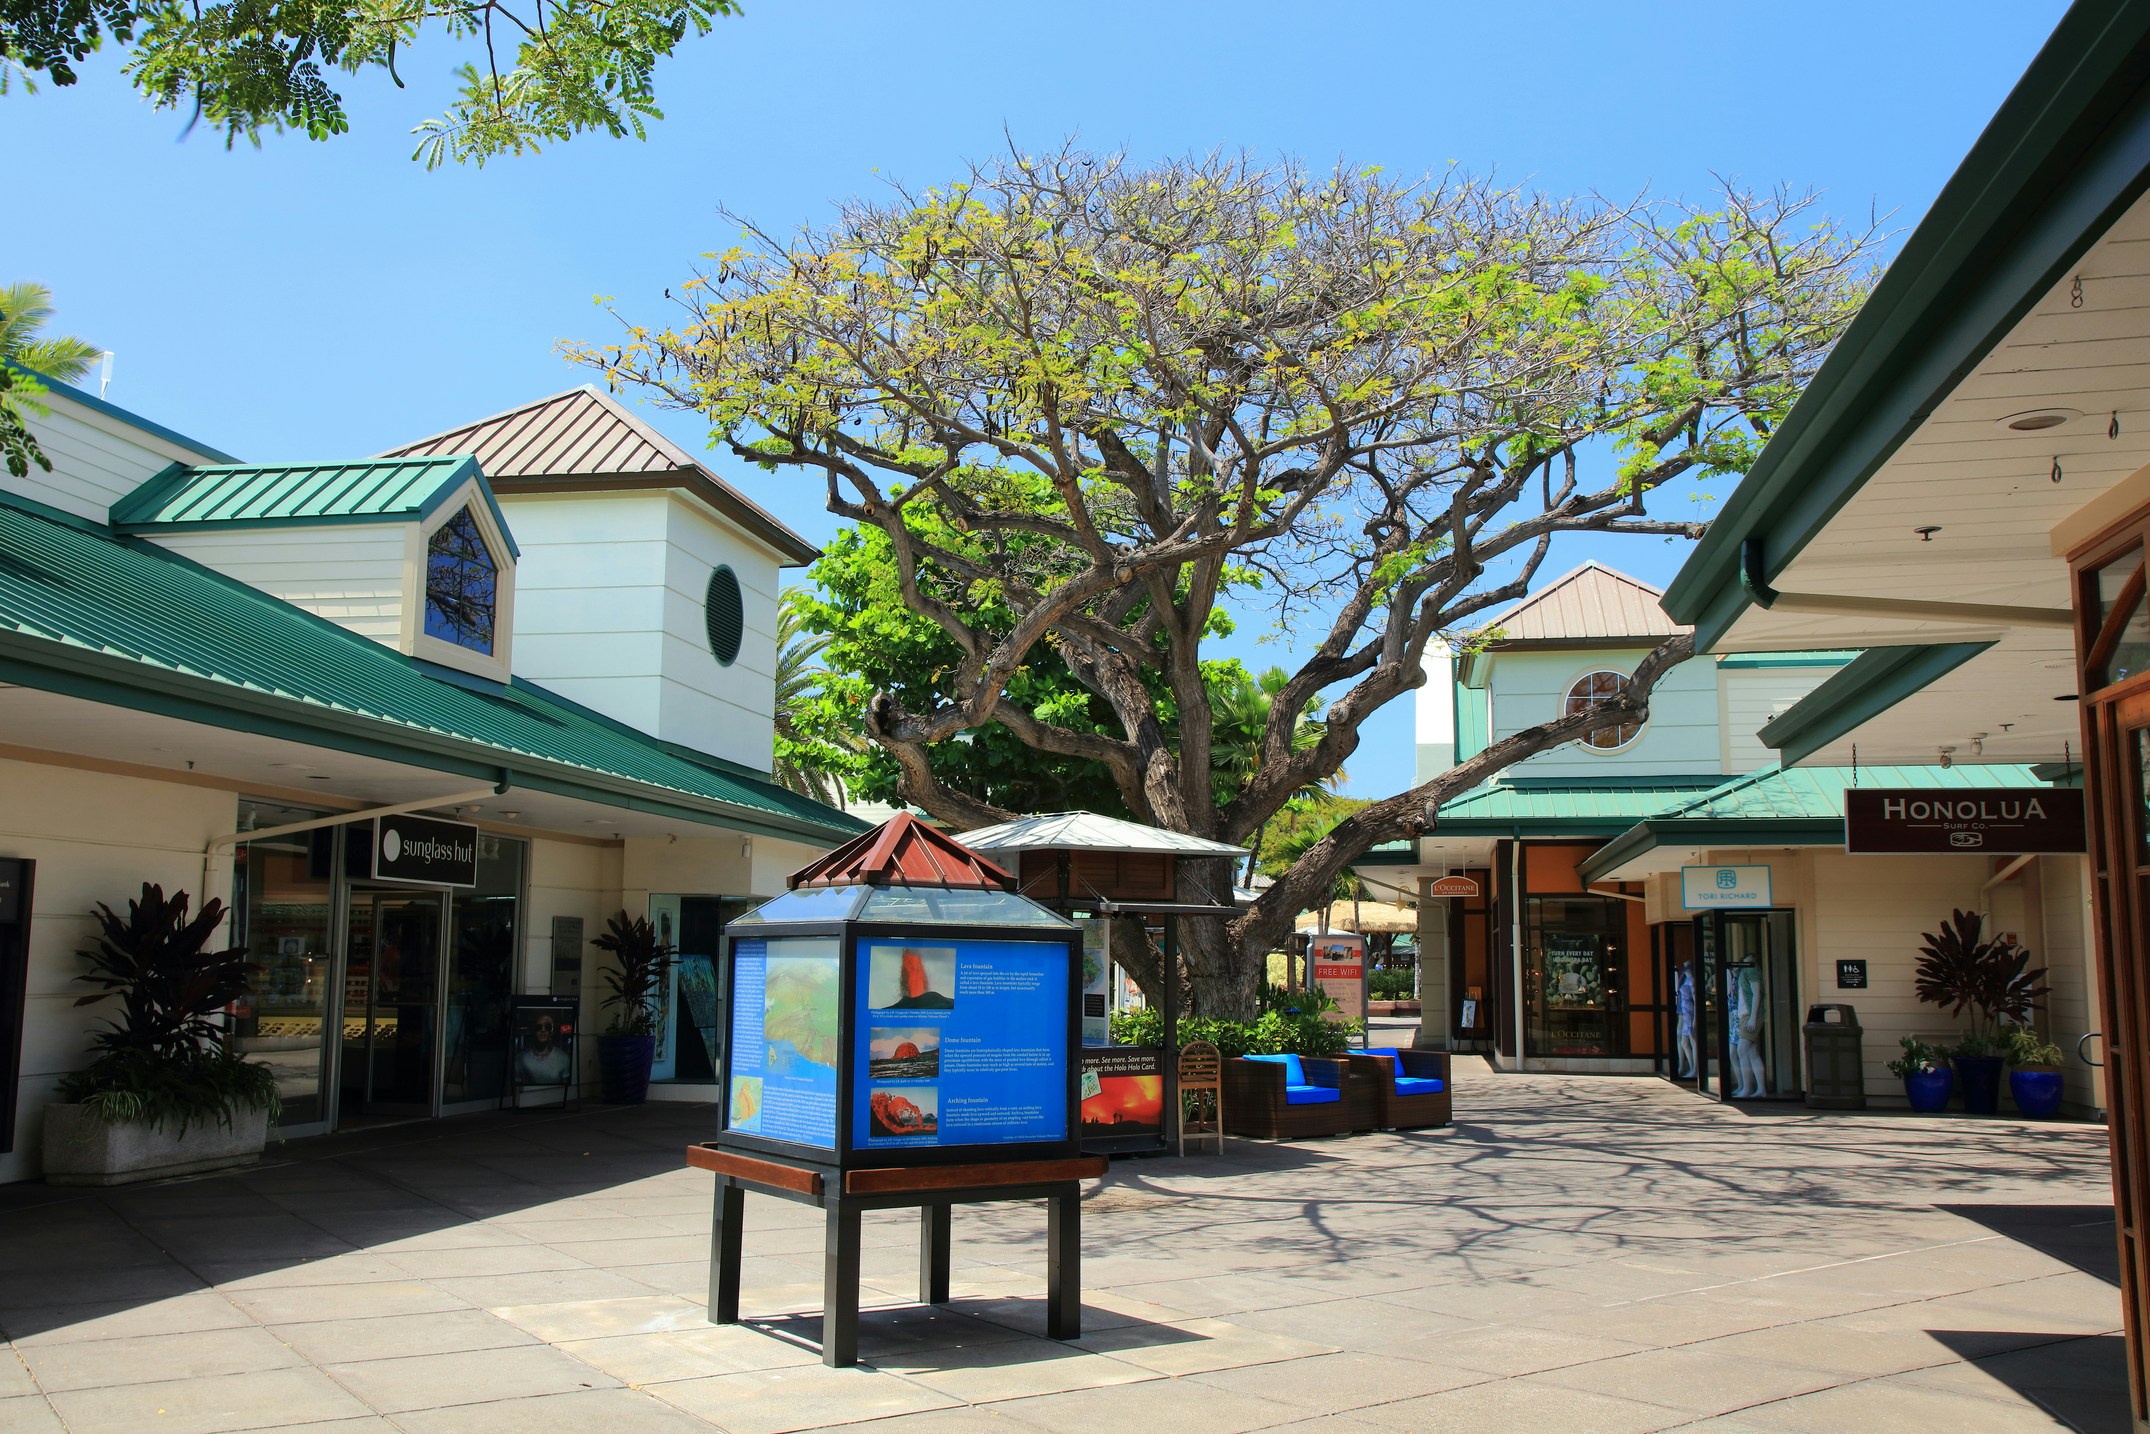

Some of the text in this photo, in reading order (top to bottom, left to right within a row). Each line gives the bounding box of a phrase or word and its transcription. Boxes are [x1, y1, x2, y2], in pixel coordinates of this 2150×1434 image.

[1884, 798, 2048, 820] HONOLUA
[403, 836, 472, 864] sunglass hut
